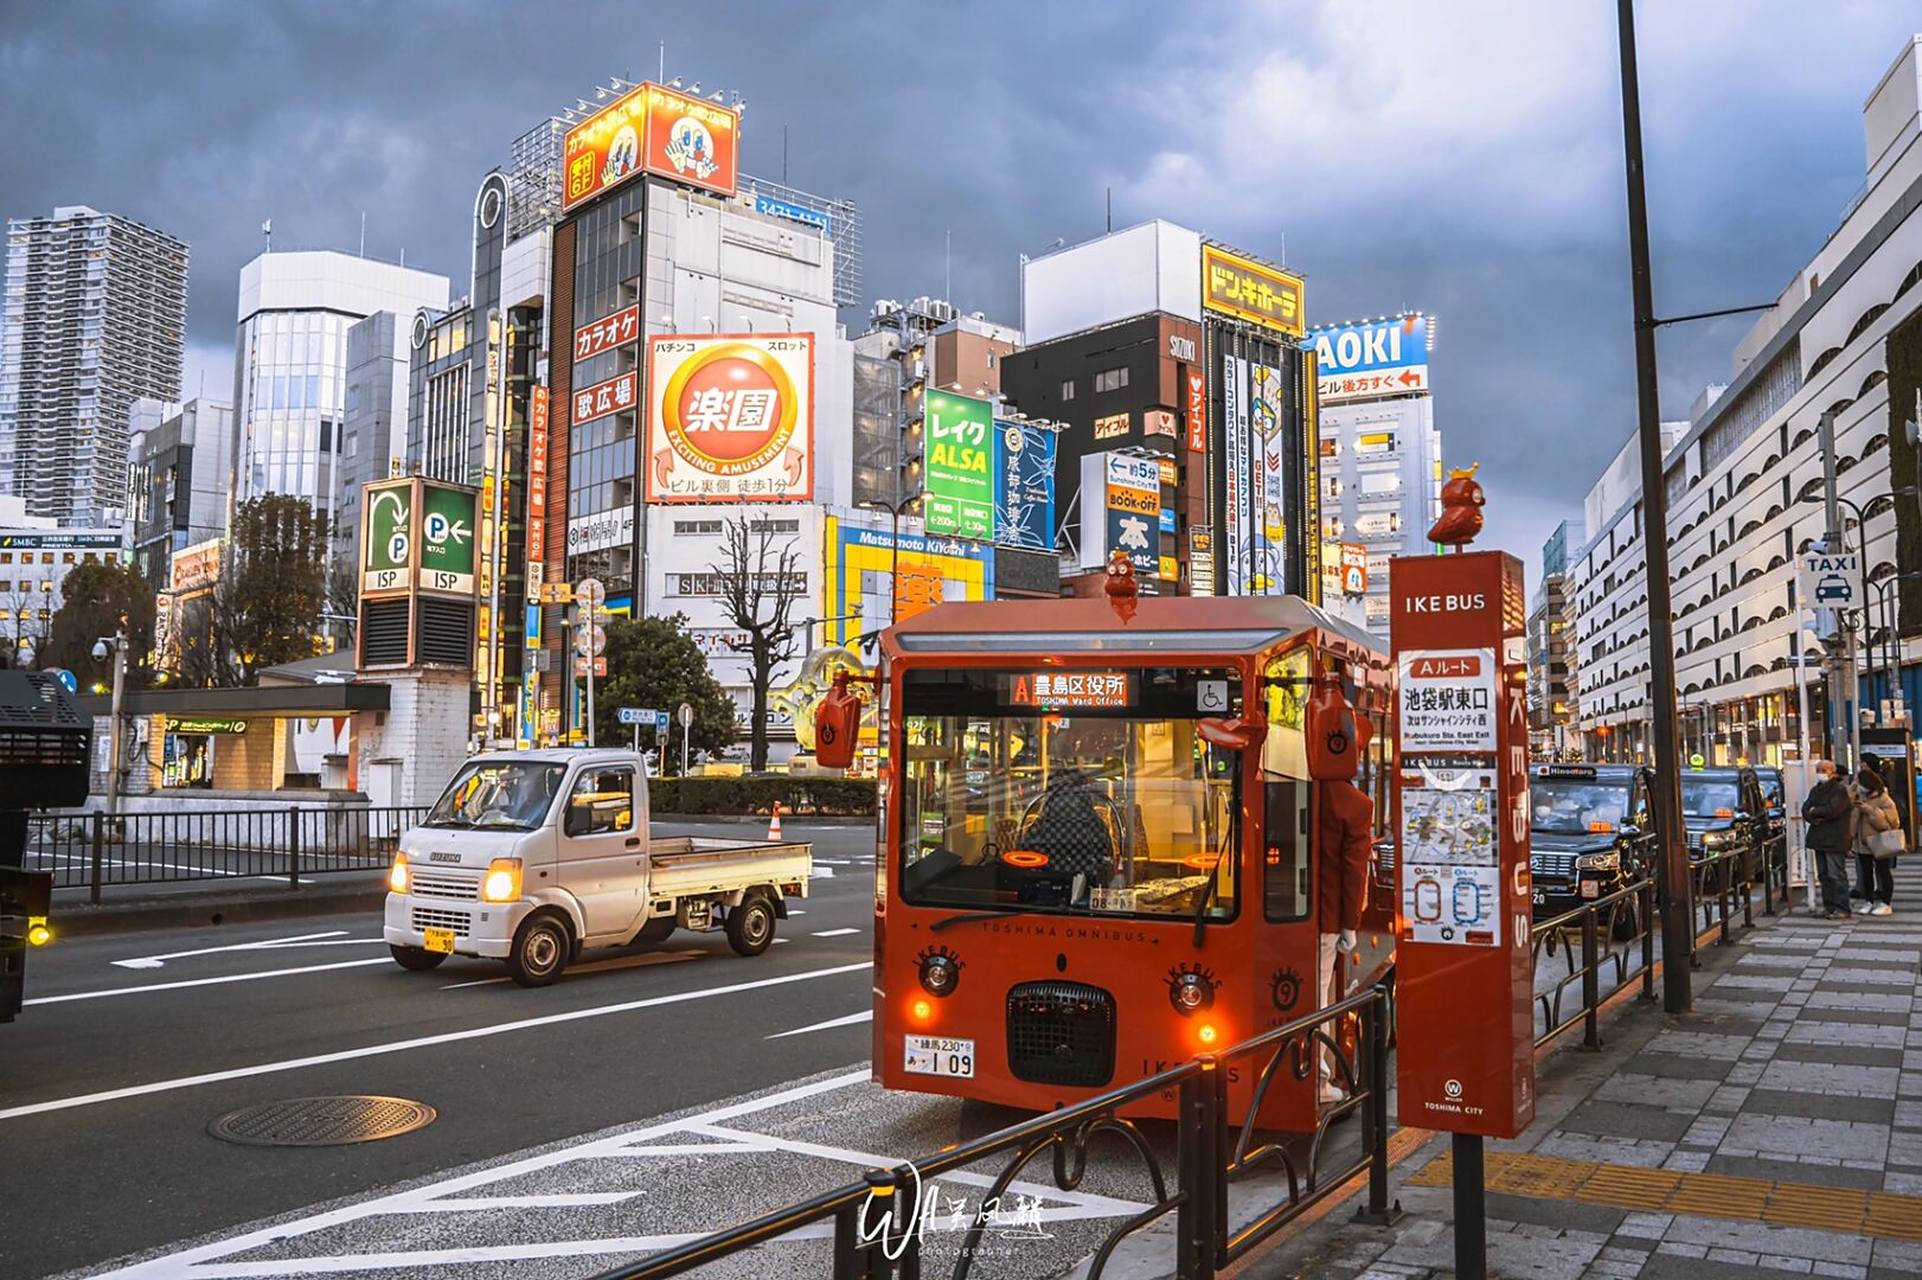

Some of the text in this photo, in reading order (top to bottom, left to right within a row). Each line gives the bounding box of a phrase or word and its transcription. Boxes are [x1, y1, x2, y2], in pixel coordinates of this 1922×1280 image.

[578, 314, 636, 356] カラオケ
[655, 342, 696, 353] パチンコ
[768, 340, 808, 351] スロット
[1316, 326, 1401, 369] AOKI
[1318, 375, 1395, 395] ビル後方すぐ
[576, 377, 632, 419] 歌広場
[685, 386, 778, 433] 楽園
[931, 413, 986, 446] レイク
[1096, 419, 1129, 435] アイフル
[1192, 392, 1203, 449] アイフル
[668, 430, 791, 476] EXCITING AMUSEMENT
[930, 443, 987, 474] ALSA
[1129, 463, 1157, 481] 約5分
[670, 478, 789, 494] ビル裏側 徒歩1分
[431, 517, 444, 538] P
[12, 537, 36, 547] SMBC
[393, 538, 405, 559] P
[859, 532, 924, 551] Matsumoto
[1807, 556, 1856, 572] TAXI
[377, 571, 398, 588] ISP
[434, 572, 458, 590] ISP
[1406, 596, 1441, 613] IKE
[1445, 594, 1486, 611] BUS
[1014, 674, 1125, 703] A 豊島区役所
[1037, 696, 1124, 705] TOSHIMA Ward Office
[1404, 686, 1489, 712] 池袋駅東口
[1406, 713, 1487, 727] 次はサンシャインシティ西
[1442, 731, 1455, 739] Sta.
[1475, 730, 1490, 738] Exit
[430, 852, 462, 862] SUZUKI
[983, 922, 1145, 942] TOSHIMA OMNIBUS
[1424, 1102, 1484, 1115] TOSHIMA CITY
